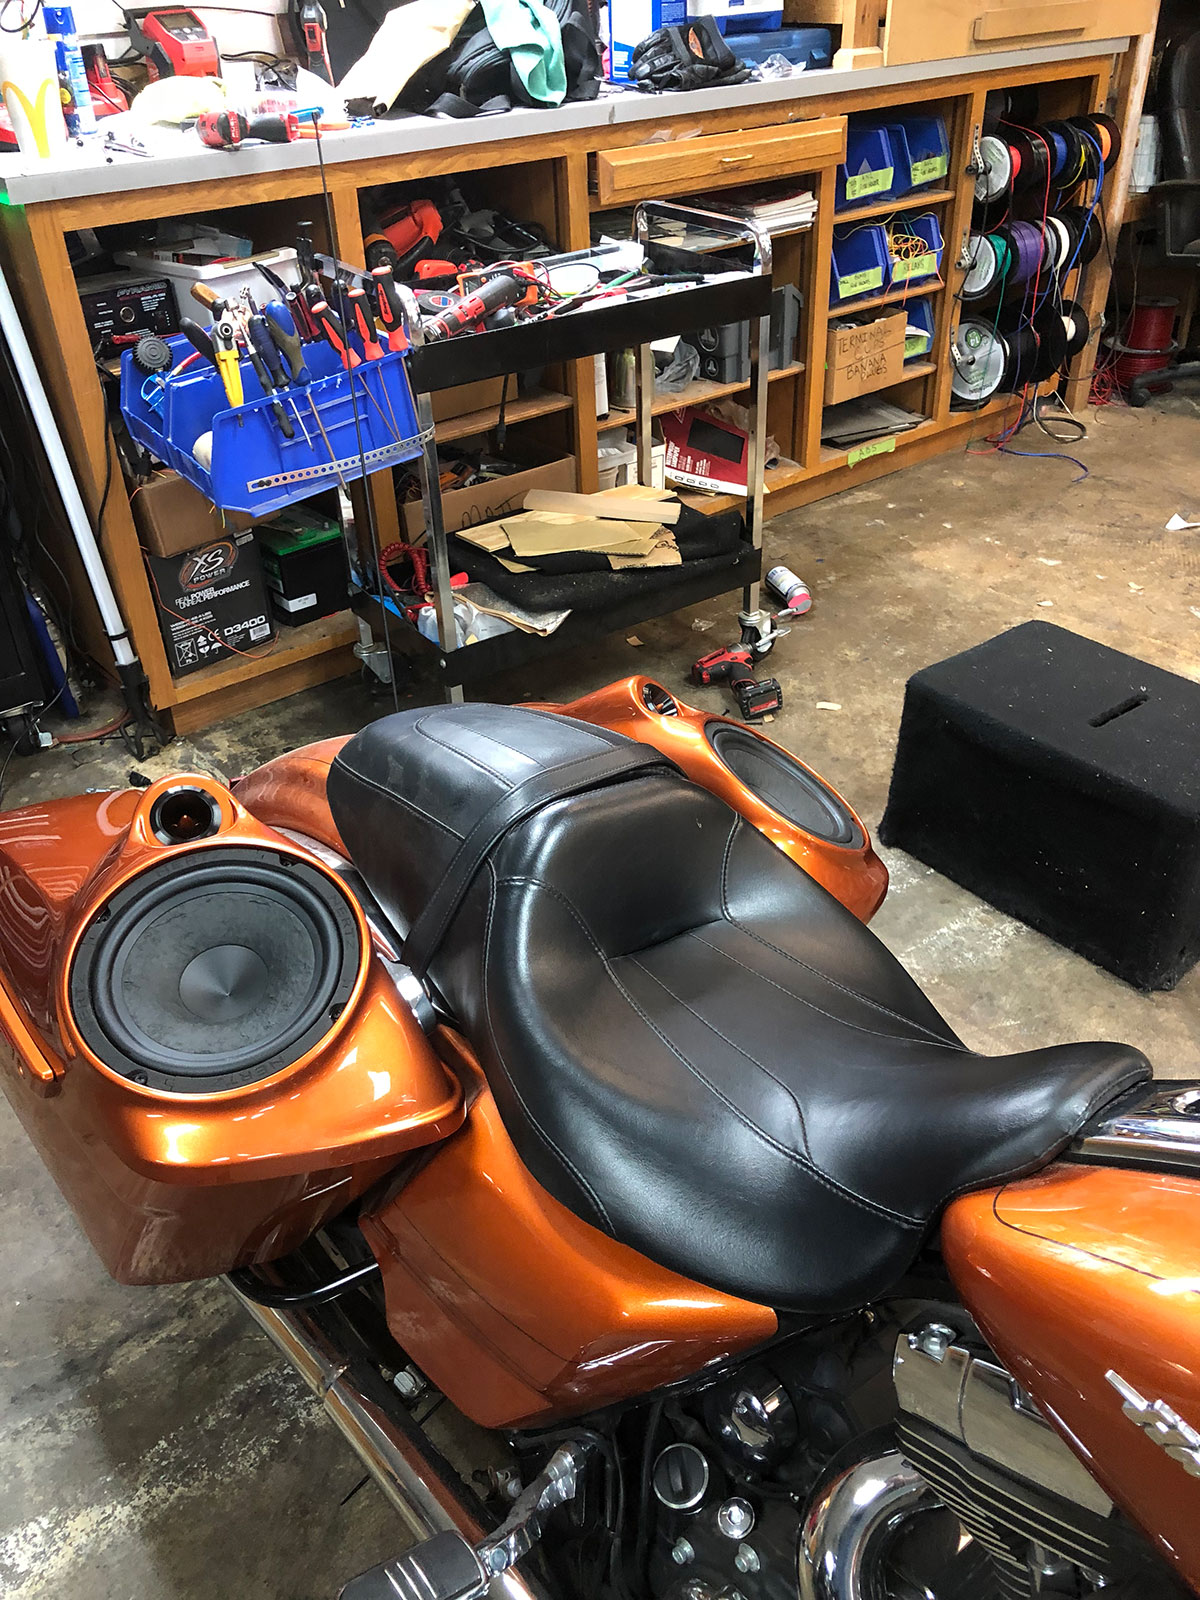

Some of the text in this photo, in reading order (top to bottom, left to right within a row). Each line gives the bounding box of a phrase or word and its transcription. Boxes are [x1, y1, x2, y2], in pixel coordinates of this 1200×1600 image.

[837, 325, 892, 355] TERMINAL
[847, 353, 887, 380] BANANA
[187, 549, 224, 585] XS
[193, 568, 226, 584] POWER
[224, 615, 266, 636] D3400
